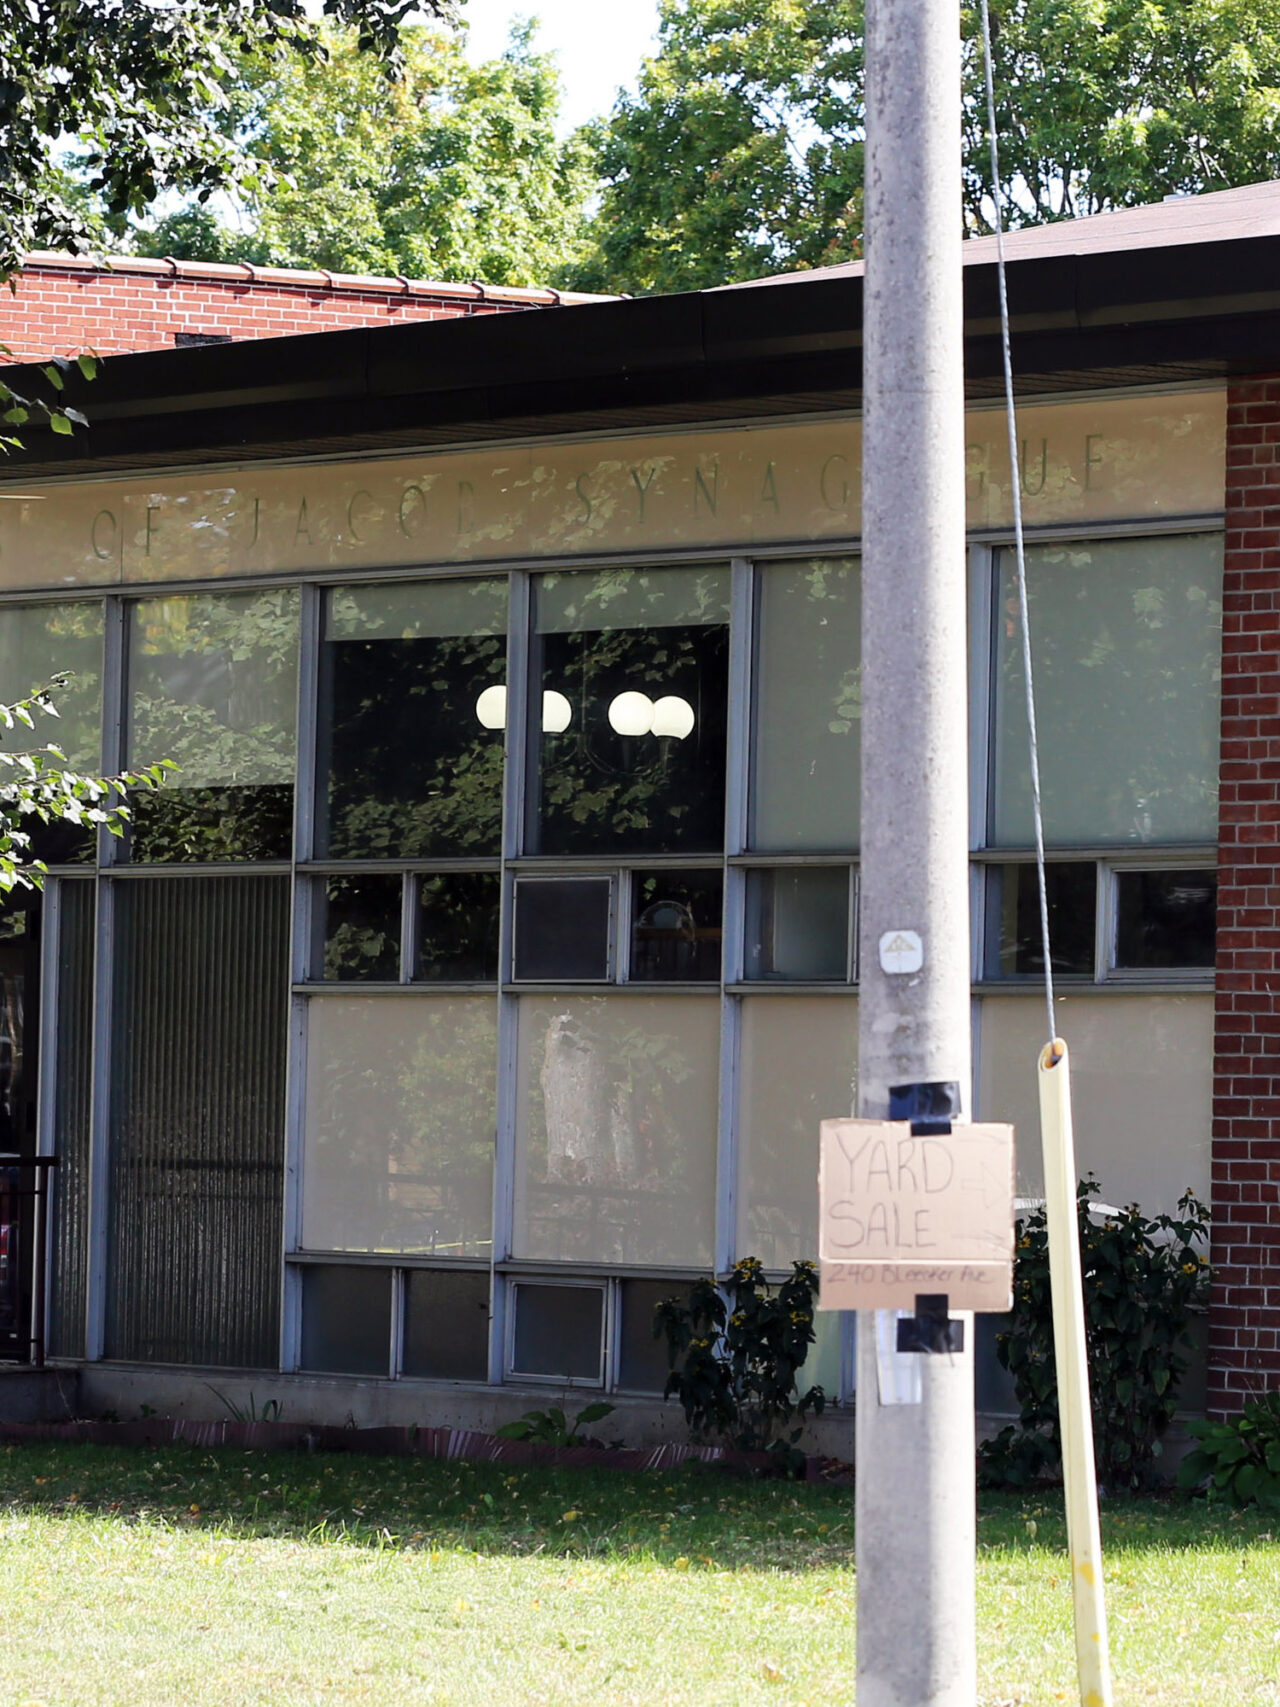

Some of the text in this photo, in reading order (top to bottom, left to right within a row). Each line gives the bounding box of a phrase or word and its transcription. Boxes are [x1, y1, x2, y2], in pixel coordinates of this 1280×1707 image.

[91, 433, 1104, 559] OF JACOB SYNAGGUE
[835, 1131, 954, 1195] YARD
[829, 1200, 937, 1249] SALE
[827, 1263, 876, 1284] 240
[960, 1265, 996, 1284] Ave
